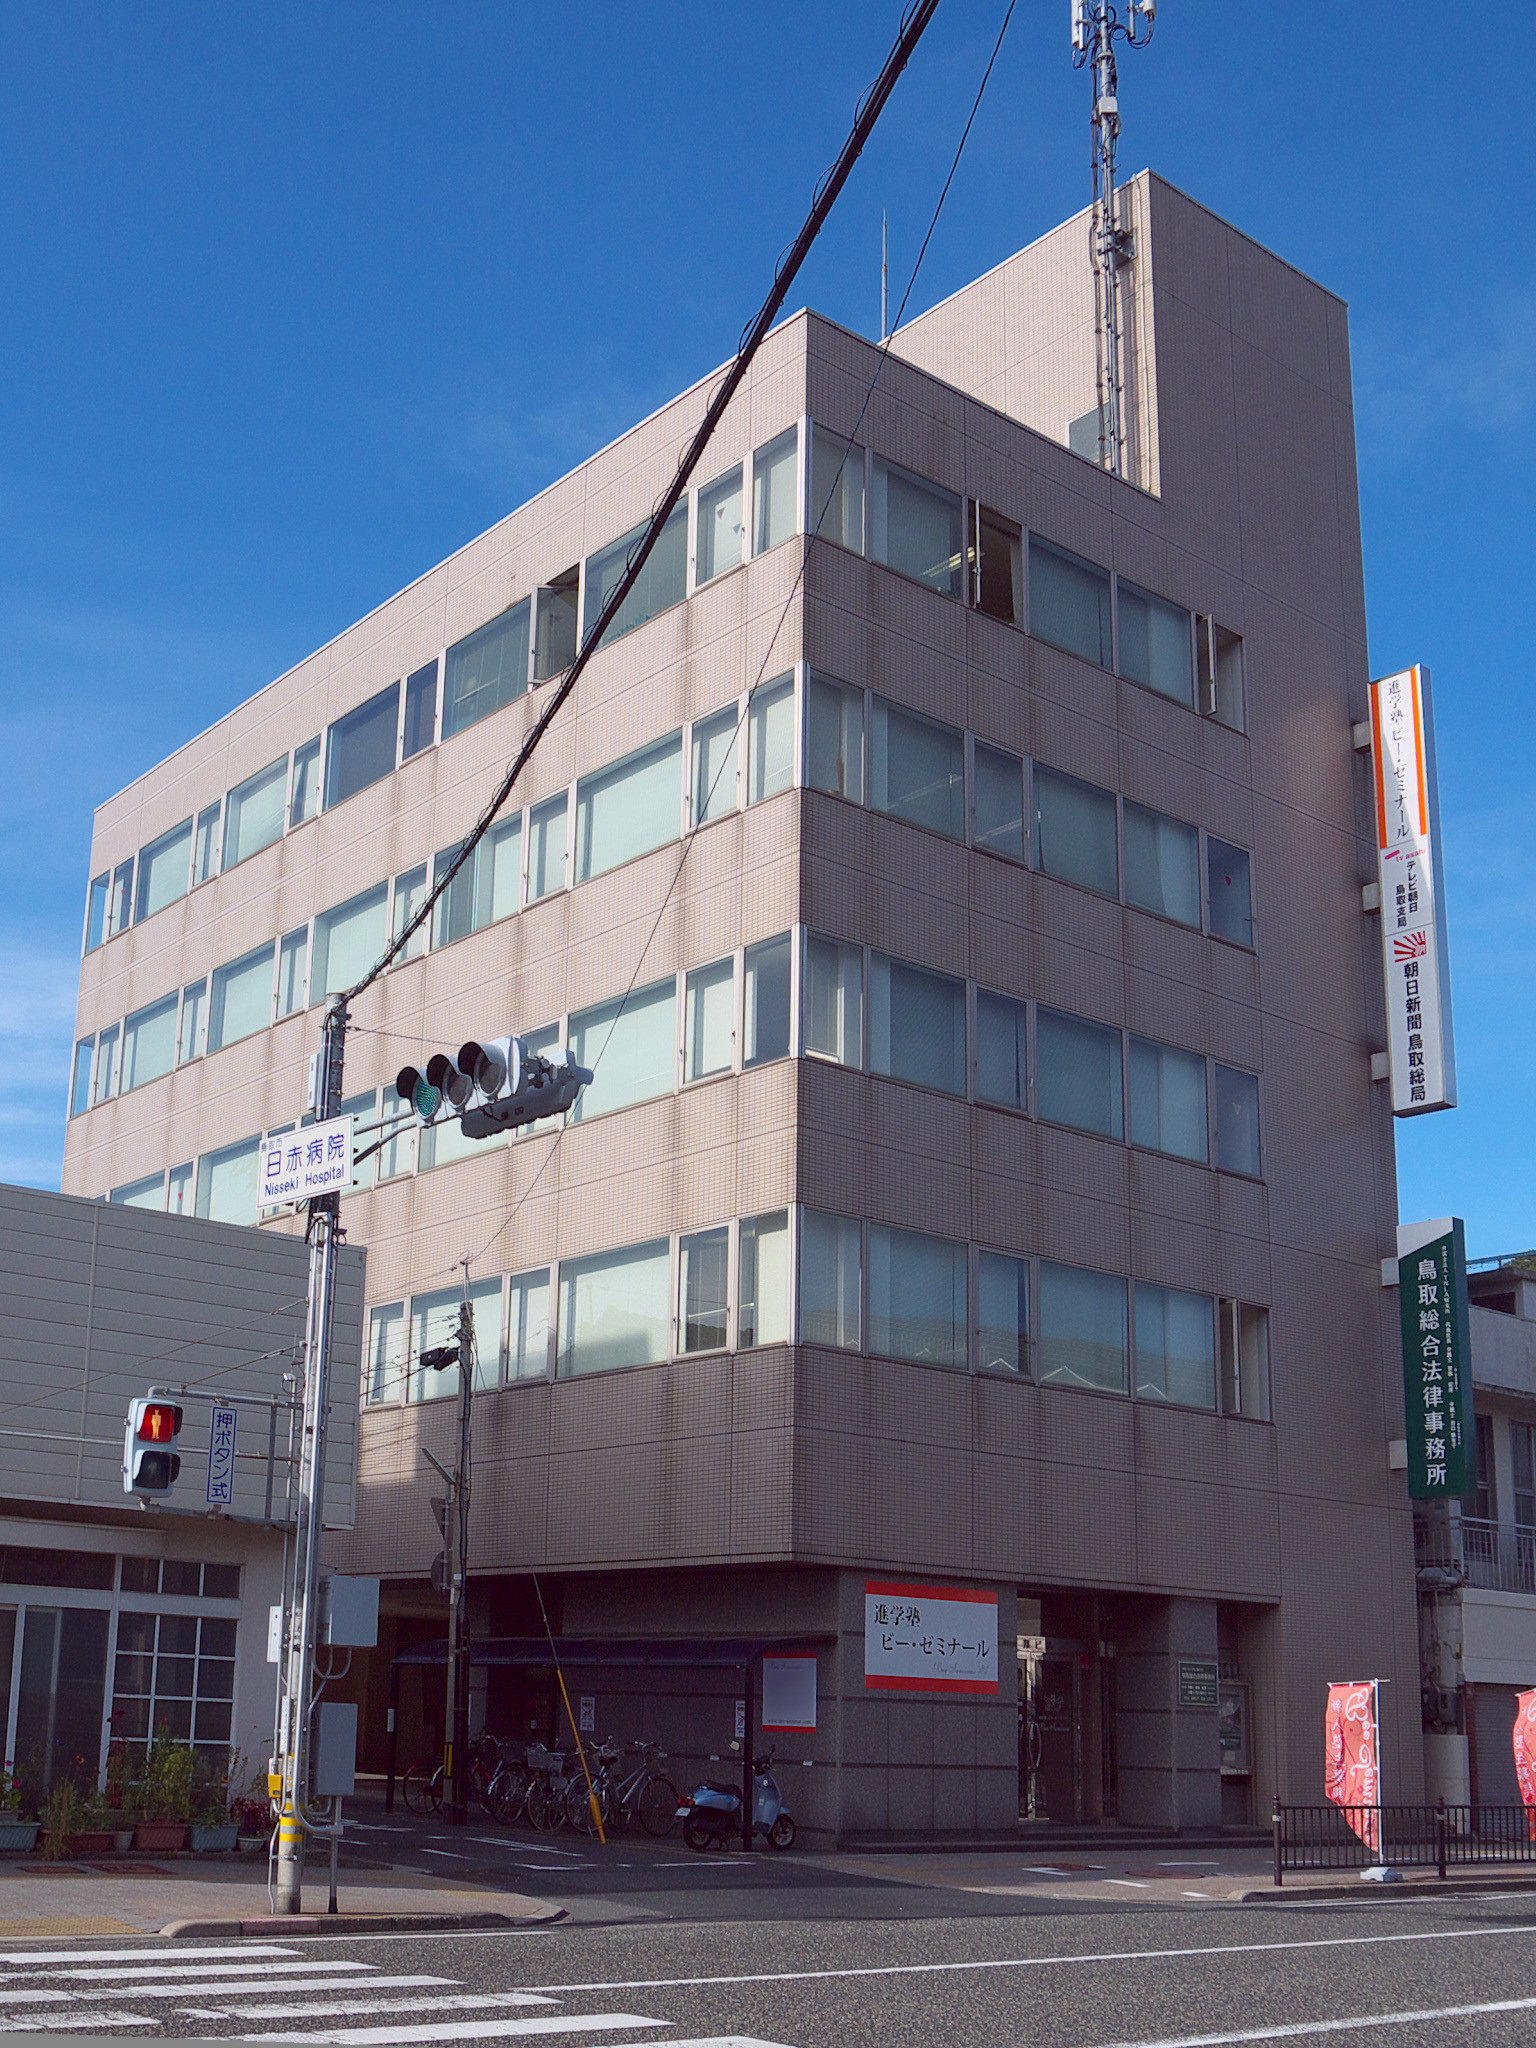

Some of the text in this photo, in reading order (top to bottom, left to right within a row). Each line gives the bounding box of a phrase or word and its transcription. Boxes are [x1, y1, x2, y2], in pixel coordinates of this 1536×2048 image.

[1395, 884, 1408, 928] 鳥取支局
[1406, 860, 1419, 914] テレビ朝日
[1403, 961, 1426, 1103] 朝日新聞鳥取総局
[266, 1134, 345, 1178] 日赤病院
[264, 1164, 345, 1197] Nisseki Hospital
[1417, 1258, 1448, 1487] 鳥取総合法律事務所
[211, 1412, 232, 1498] 押ボタン式
[874, 1602, 921, 1628] 進学塾
[881, 1632, 991, 1659] ビー・ゼミナール
